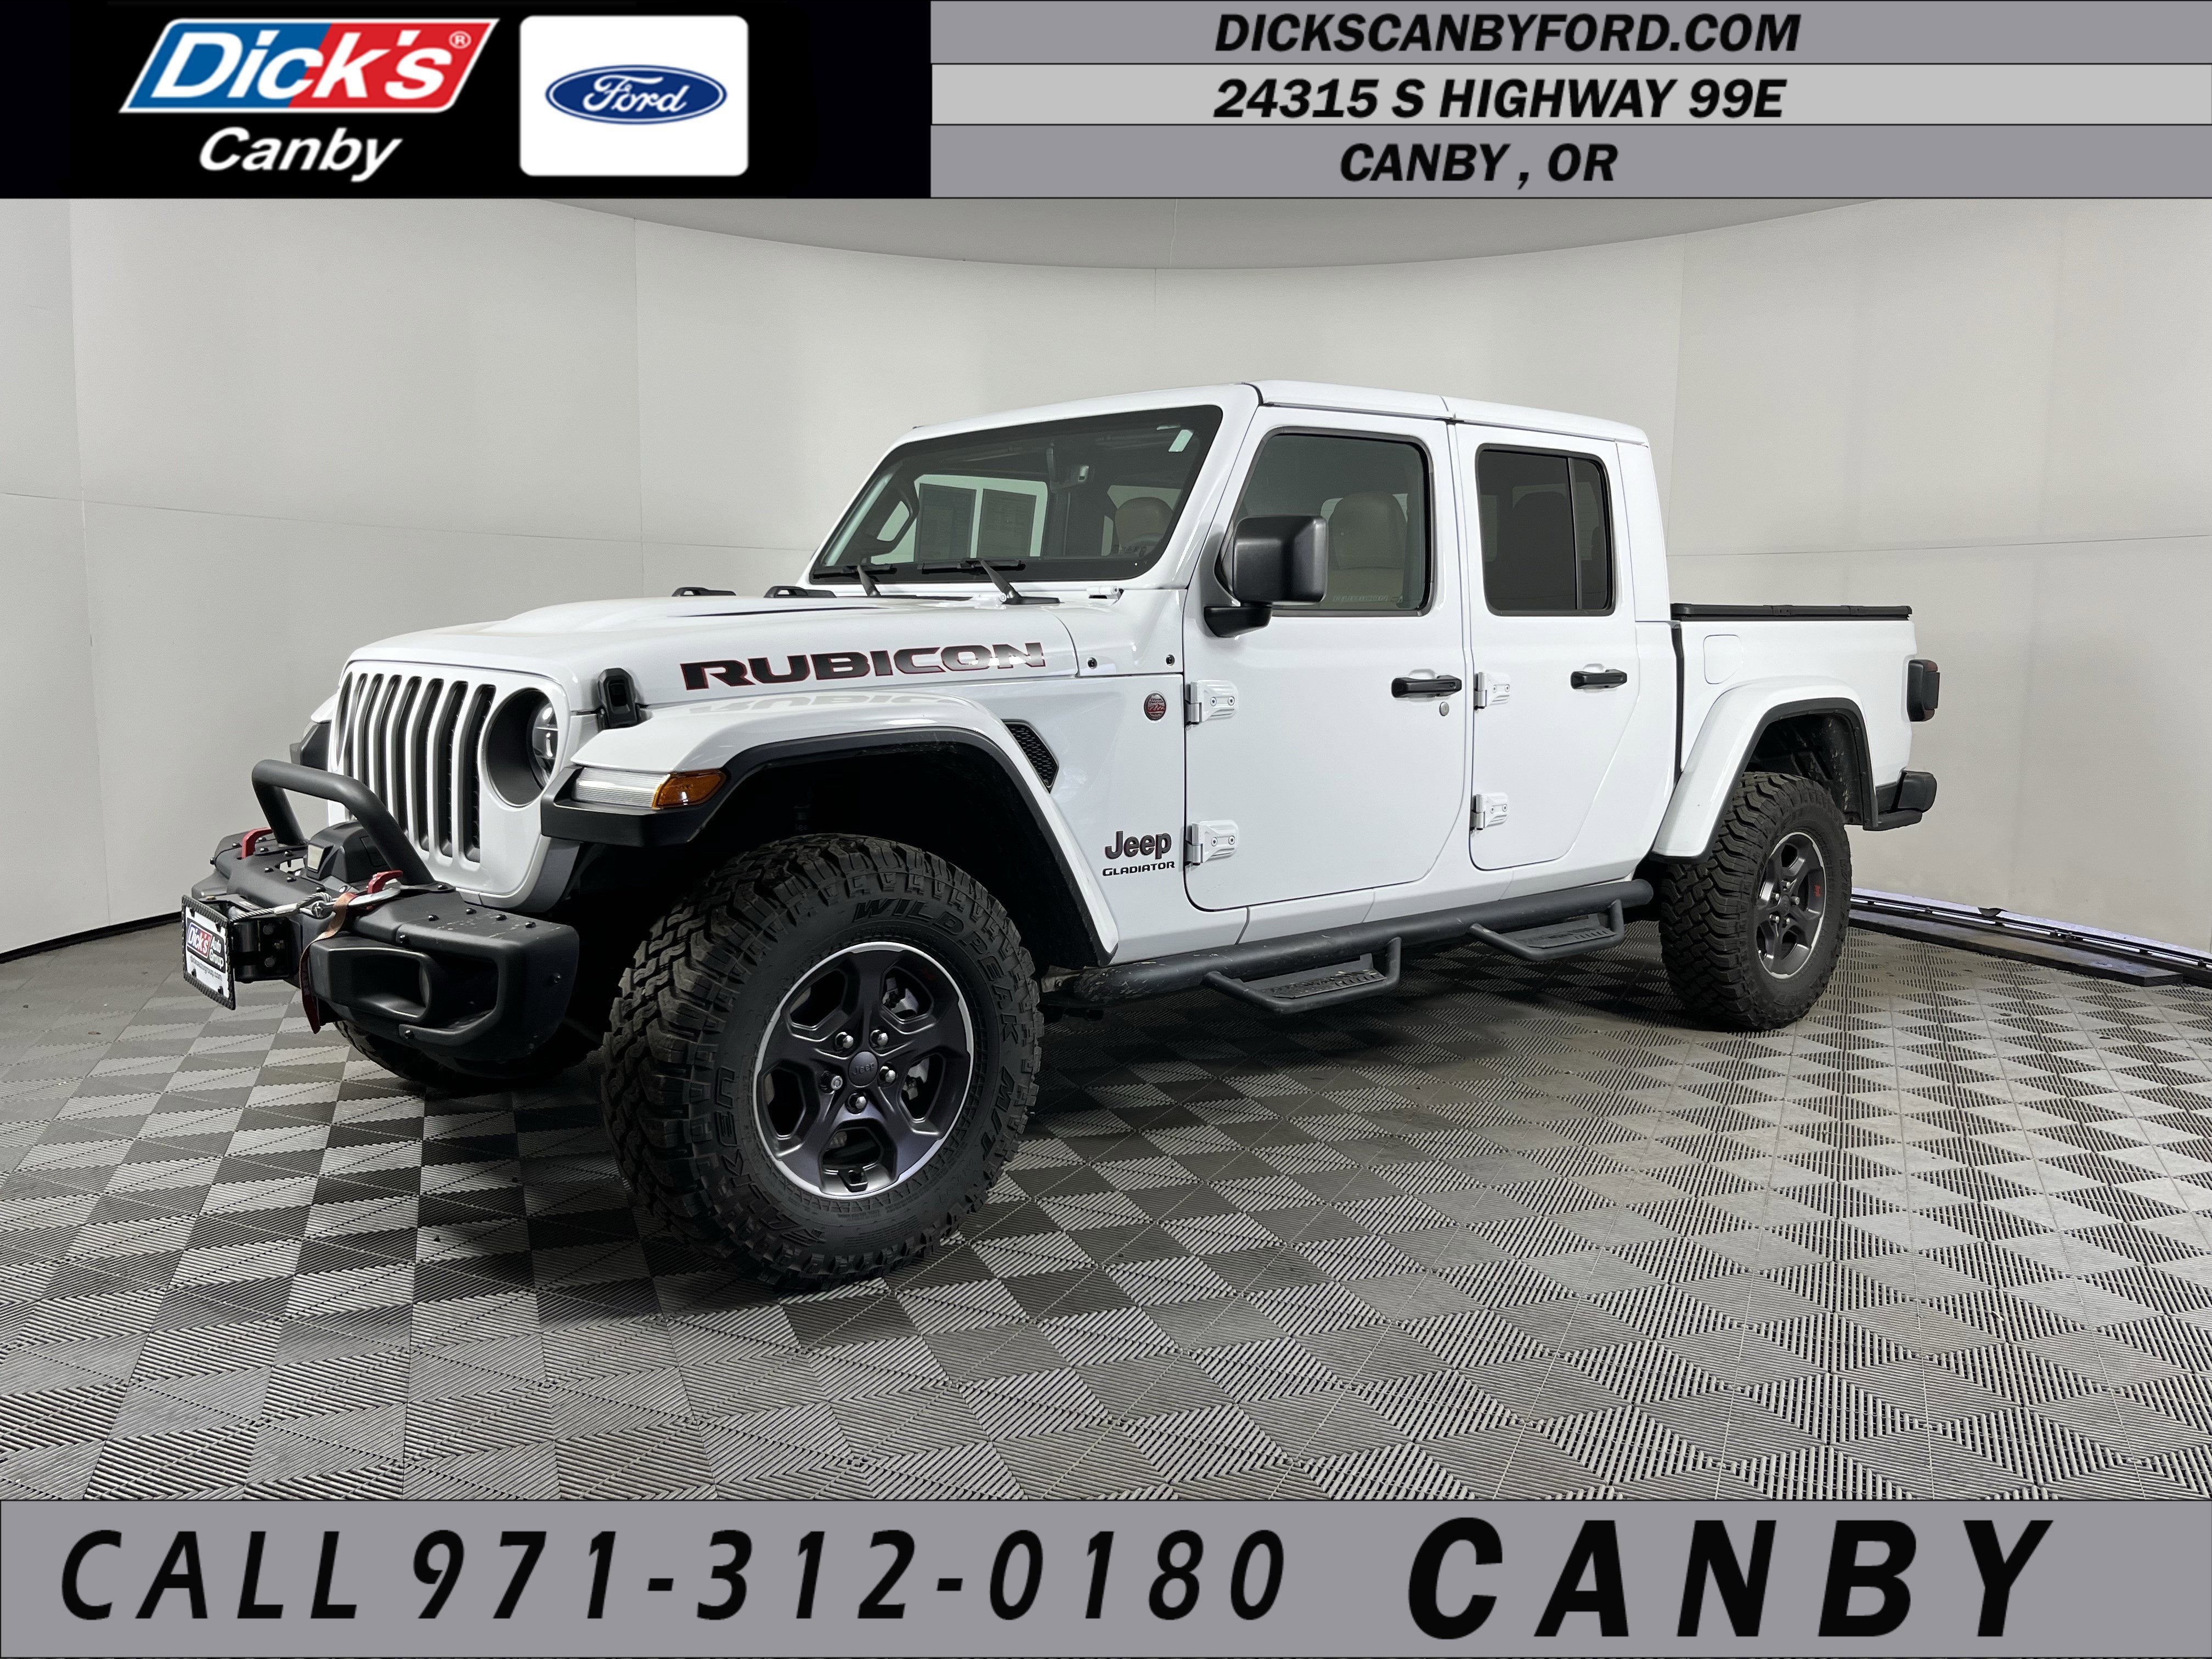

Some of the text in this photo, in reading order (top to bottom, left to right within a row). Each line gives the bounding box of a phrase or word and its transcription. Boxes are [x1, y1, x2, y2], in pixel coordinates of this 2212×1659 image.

[680, 642, 1046, 690] RUBICON
[1105, 831, 1172, 860] Jeep
[1102, 861, 1175, 876] GLADIATOR
[188, 926, 208, 953] Dick's
[211, 936, 222, 953] Auto
[209, 949, 224, 969] Group
[853, 898, 1018, 1043] WILDPEAK
